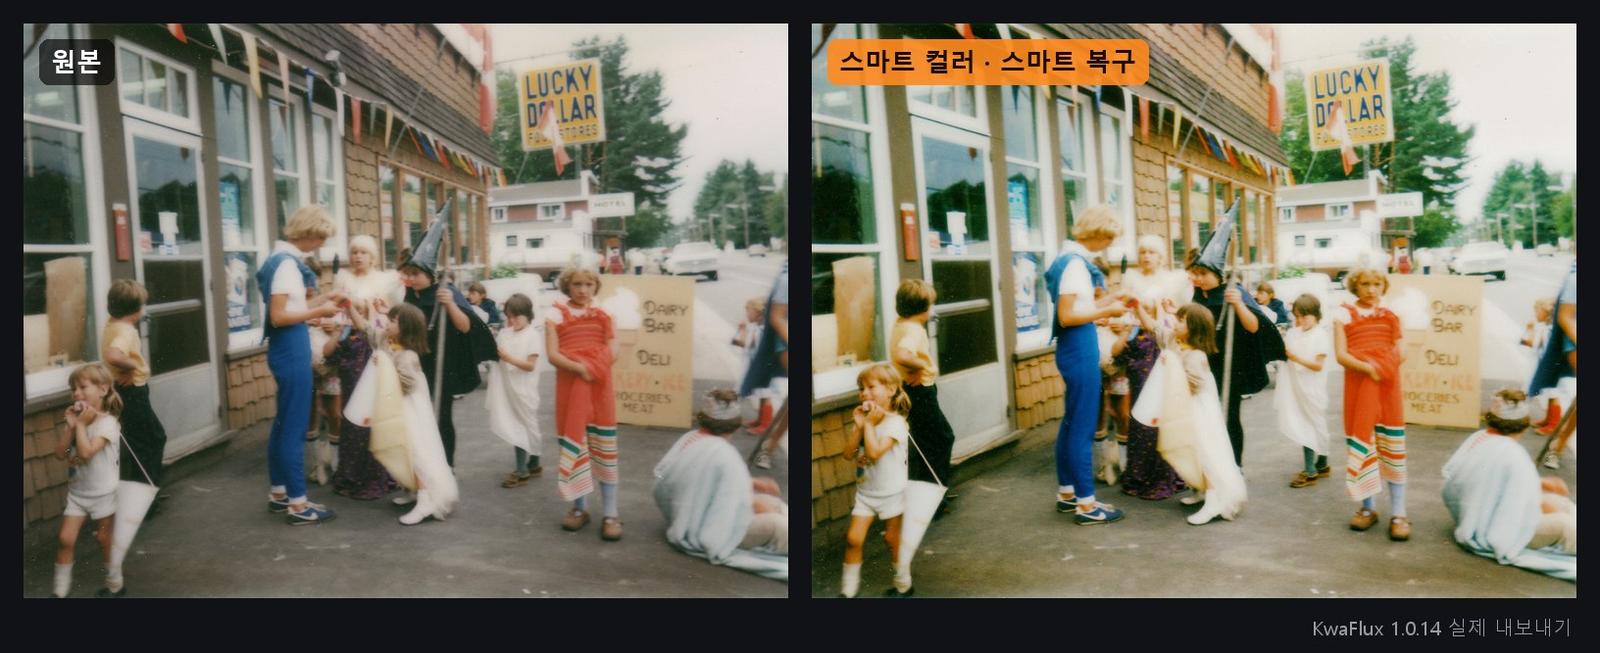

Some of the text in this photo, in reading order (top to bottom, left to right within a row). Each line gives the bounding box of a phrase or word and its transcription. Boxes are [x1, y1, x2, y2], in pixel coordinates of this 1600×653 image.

[525, 64, 592, 99] LUCKY
[1314, 64, 1380, 99] LUCKY
[527, 94, 597, 128] DLAR
[1315, 94, 1385, 128] DLAR
[643, 299, 689, 316] DAIRY
[1431, 299, 1477, 316] DAIRY
[643, 317, 675, 333] BAR
[1431, 317, 1463, 333] BAR
[636, 349, 671, 366] DELI
[1425, 349, 1459, 366] DELI
[623, 402, 655, 413] MEAT
[1411, 402, 1443, 413] MEAT
